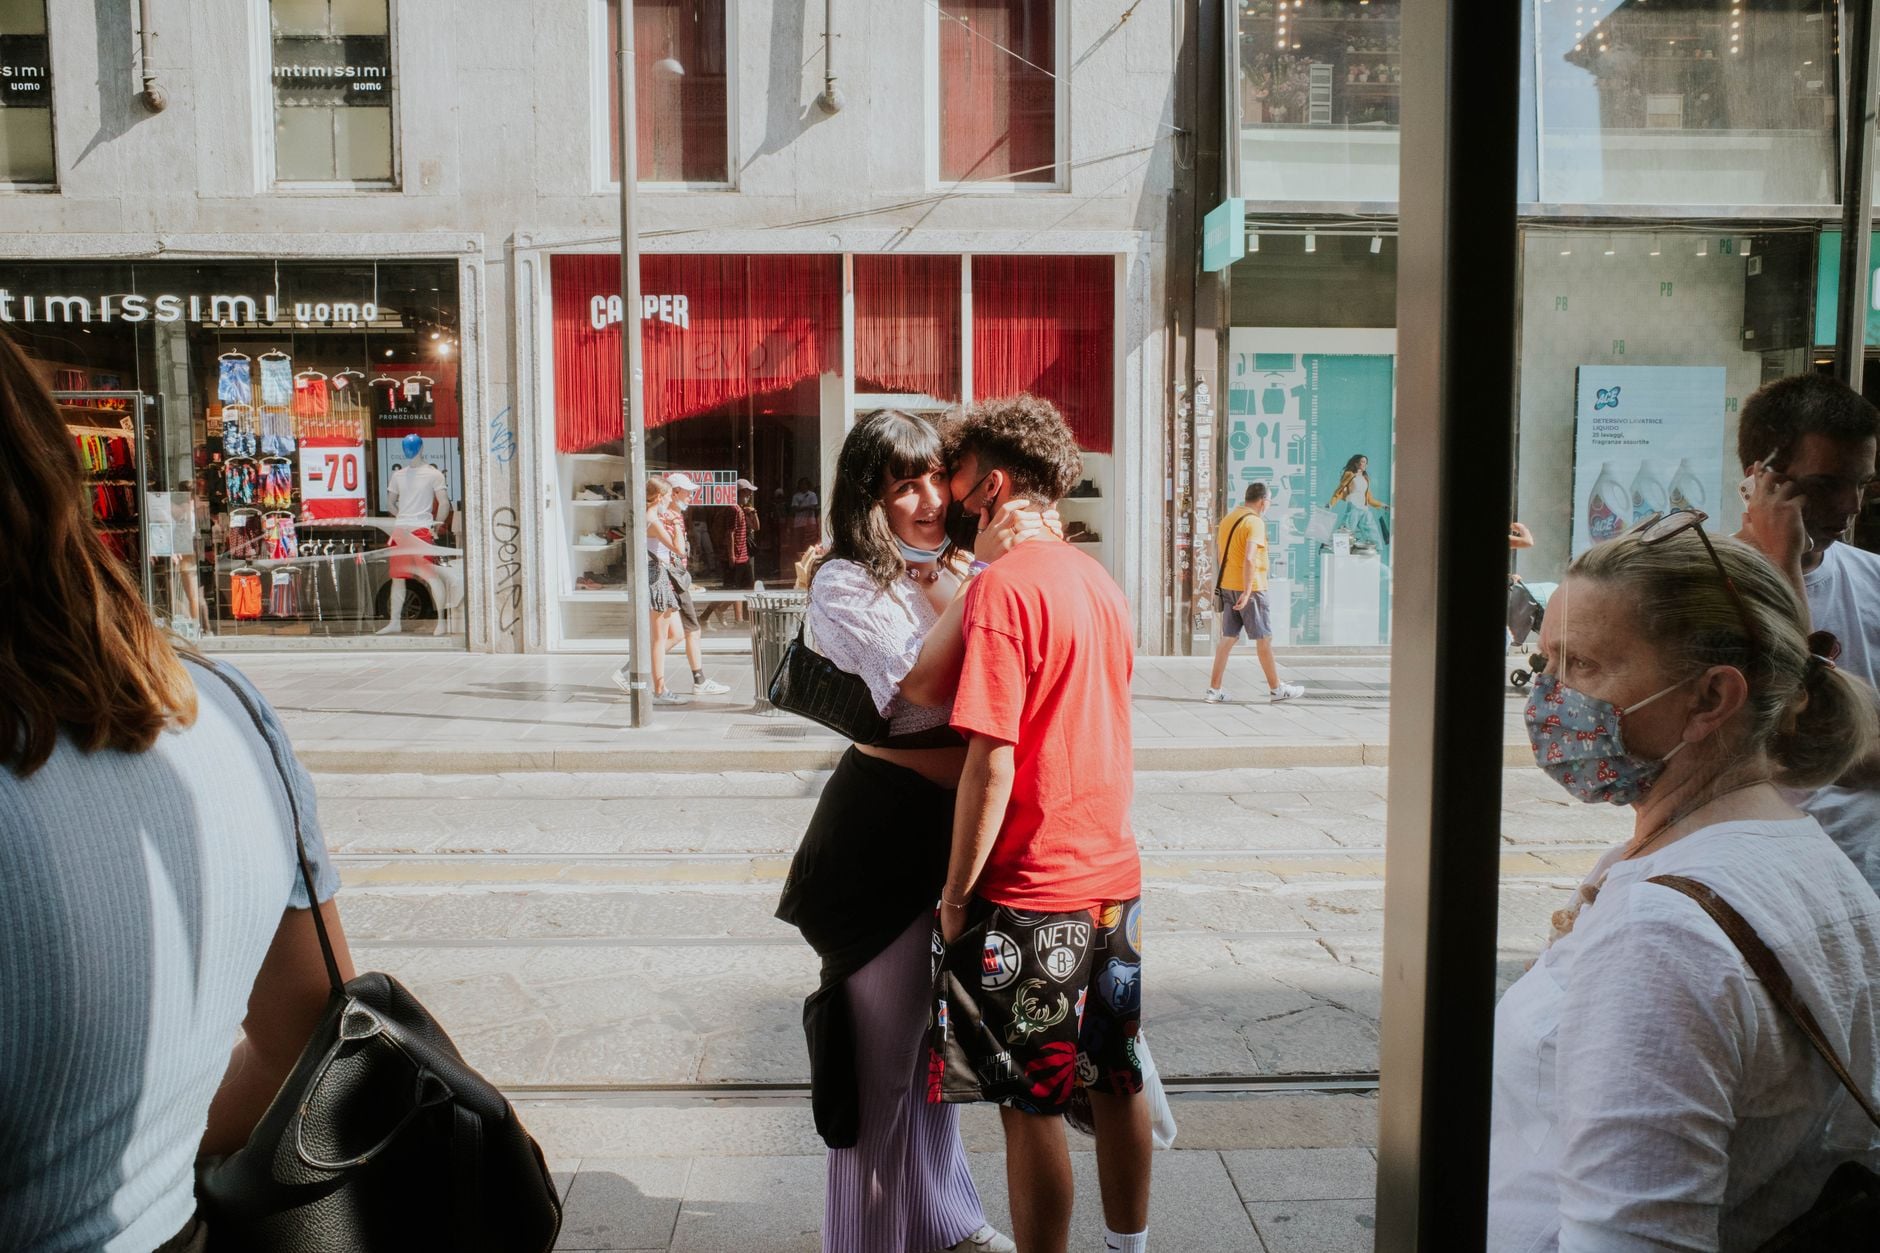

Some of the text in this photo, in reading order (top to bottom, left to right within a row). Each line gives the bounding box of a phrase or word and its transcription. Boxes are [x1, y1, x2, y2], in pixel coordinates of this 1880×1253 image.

[274, 64, 386, 77] intimissimi
[11, 82, 40, 91] uomo
[353, 82, 382, 91] uomo
[1720, 239, 1732, 254] PB
[1660, 282, 1673, 297] PB
[1555, 296, 1568, 311] PB
[294, 302, 379, 322] uomo
[591, 295, 689, 330] CAPER
[1612, 339, 1625, 354] PB
[1725, 397, 1738, 412] PB
[379, 413, 433, 421] PROMOZIONALE
[1038, 923, 1087, 951] NETS
[1057, 951, 1067, 973] B
